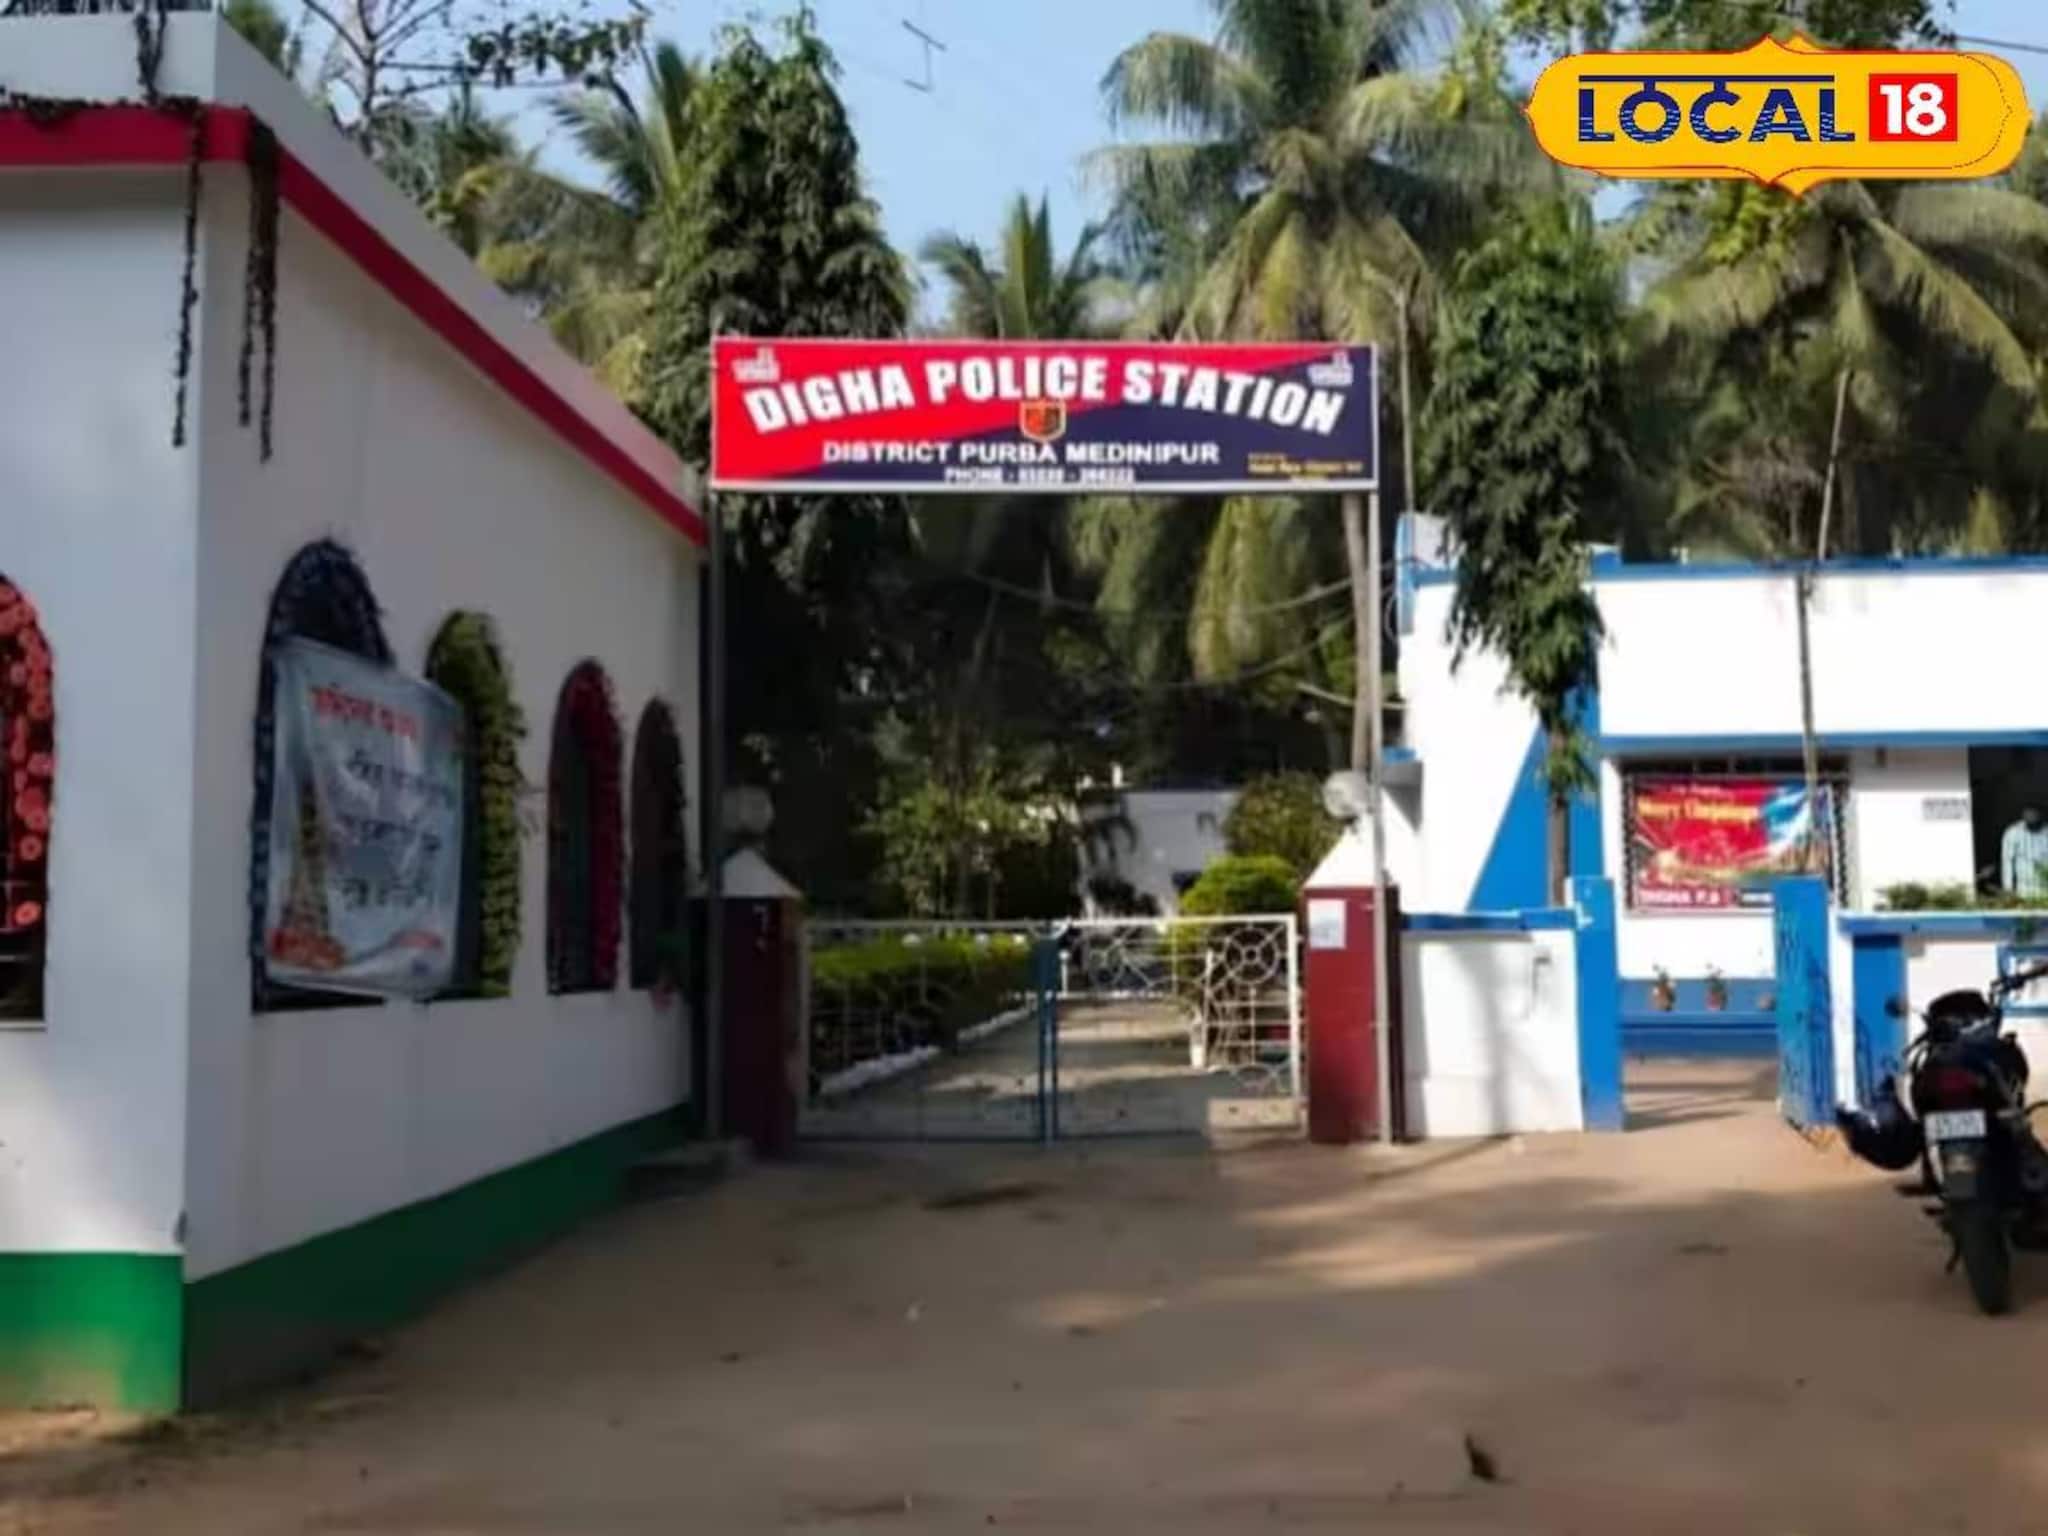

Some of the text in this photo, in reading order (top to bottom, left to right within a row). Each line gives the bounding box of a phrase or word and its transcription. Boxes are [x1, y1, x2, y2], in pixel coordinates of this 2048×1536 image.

[743, 356, 1347, 436] DIGHA POLICE STATION
[822, 440, 1220, 465] DISTRICT PURBA MEDINIPUR
